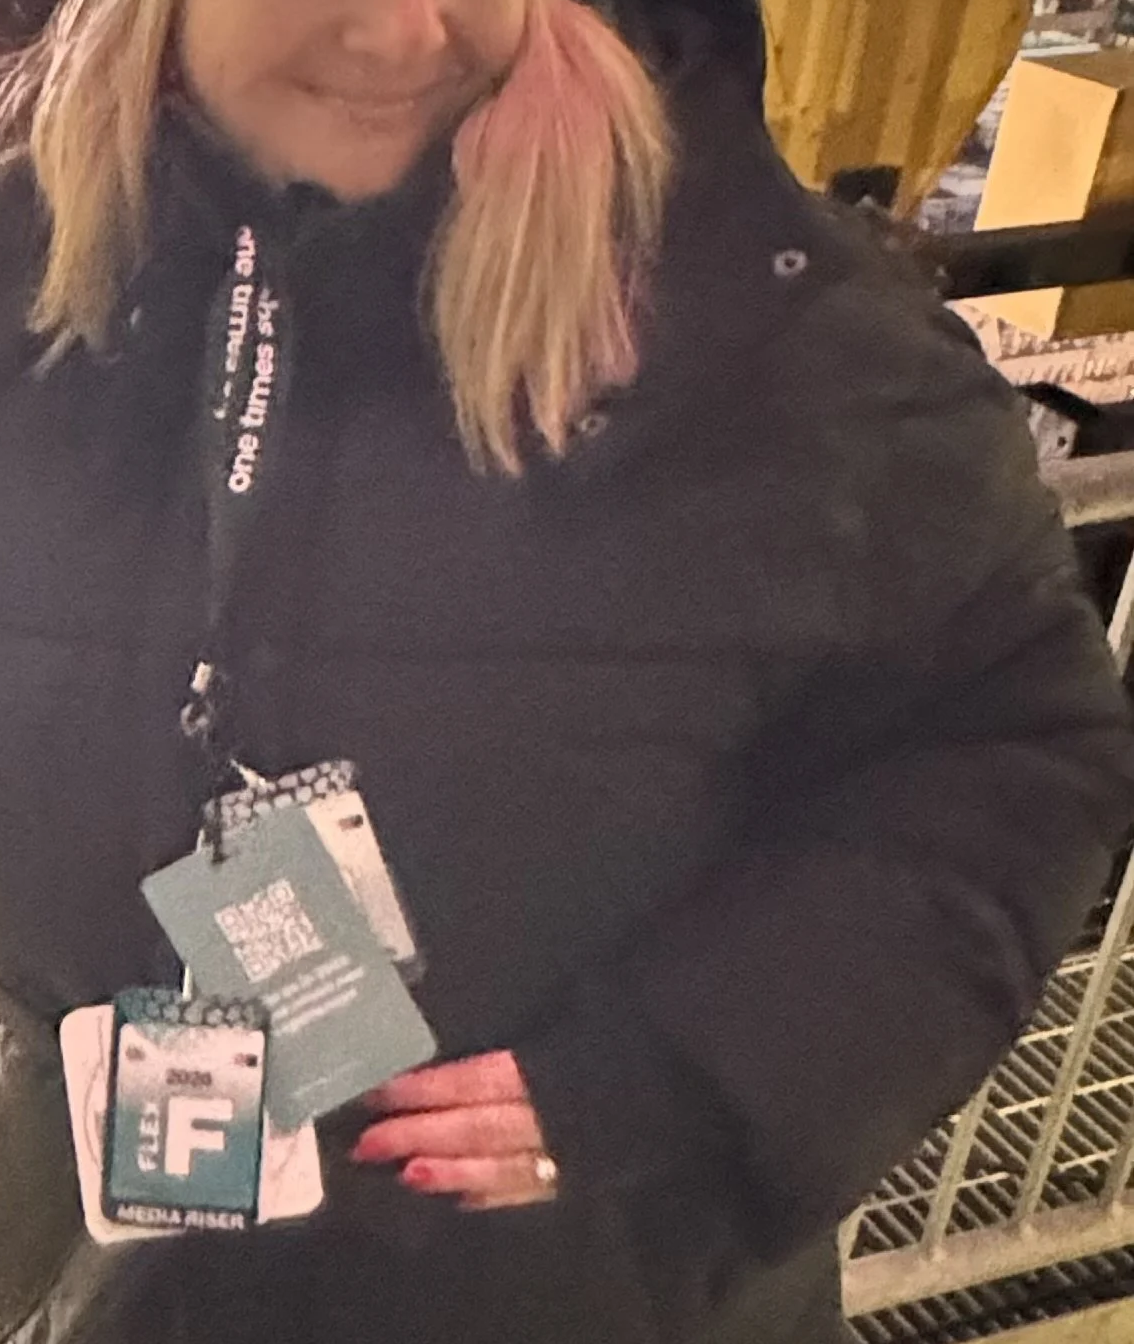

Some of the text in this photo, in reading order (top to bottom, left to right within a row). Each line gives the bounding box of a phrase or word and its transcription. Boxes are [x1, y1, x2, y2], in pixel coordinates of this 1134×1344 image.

[235, 225, 256, 277] one
[240, 343, 275, 428] times
[228, 432, 260, 494] one
[164, 1098, 234, 1176] F
[116, 1204, 246, 1231] MEDIA RISER
